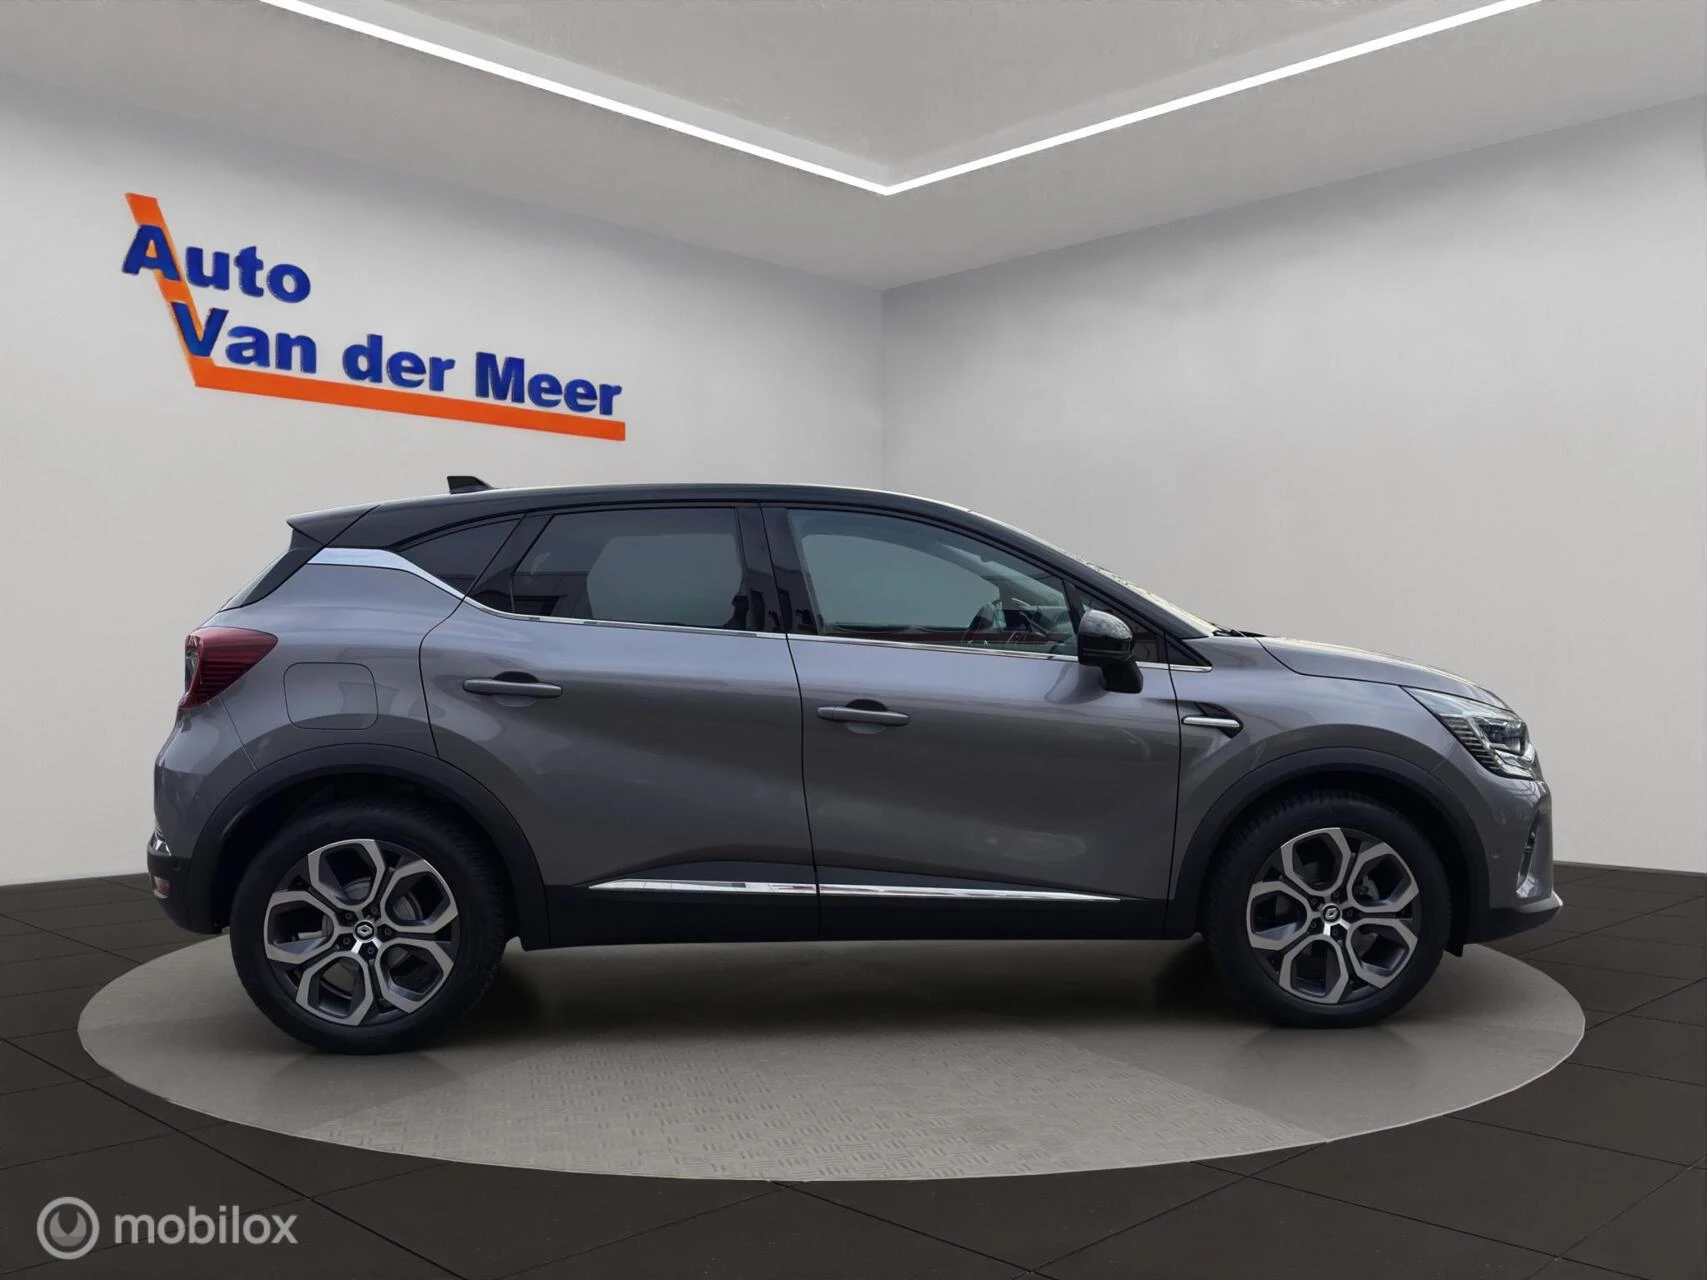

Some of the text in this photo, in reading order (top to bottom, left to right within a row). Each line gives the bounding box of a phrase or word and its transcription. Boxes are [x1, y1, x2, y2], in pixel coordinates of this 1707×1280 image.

[122, 224, 311, 304] Auto
[171, 301, 622, 416] Van der Meer
